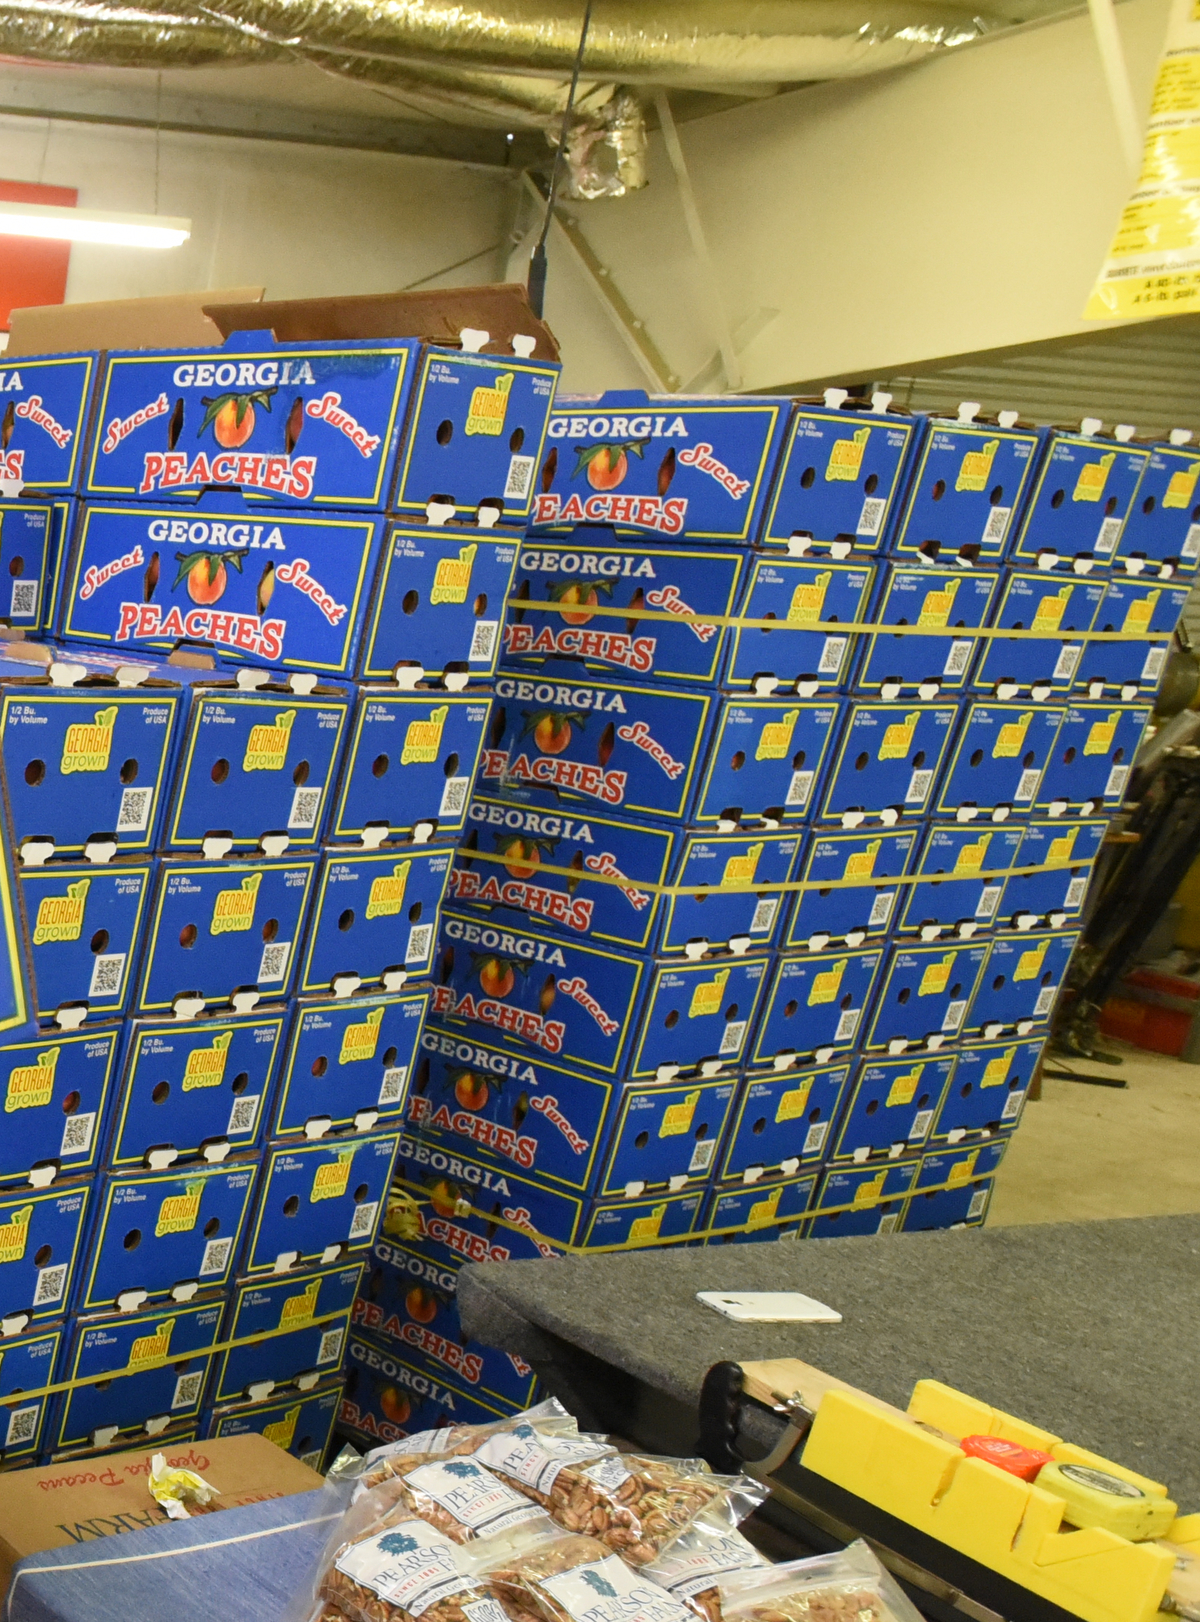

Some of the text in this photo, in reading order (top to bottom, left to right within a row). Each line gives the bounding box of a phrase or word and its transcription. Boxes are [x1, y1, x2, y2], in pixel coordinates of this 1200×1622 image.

[173, 361, 316, 387] GEORGIA
[16, 395, 73, 449] Sweet
[102, 392, 169, 454] Sweet
[305, 391, 381, 458] Sweet
[468, 417, 502, 431] grown
[547, 417, 688, 438] GEORGIA
[139, 452, 317, 499] PEACHES
[678, 442, 751, 500] Sweet
[531, 493, 688, 535] EACHES
[148, 520, 286, 550] GEORGIA
[80, 544, 144, 600] Sweet
[520, 552, 656, 578] GEORGIA
[275, 558, 348, 626] Sweet
[115, 602, 286, 660] PEACHES
[504, 623, 657, 672] EACHES
[495, 680, 627, 713] GEORGIA
[9, 716, 48, 725] by Volume
[143, 707, 169, 715] Produce
[145, 715, 167, 724] of USA
[67, 728, 109, 753] GEORGIA
[248, 728, 287, 753] GEORGIA
[406, 723, 441, 747] GEORGIA
[64, 754, 106, 769] grown
[247, 752, 285, 767] grown
[403, 747, 436, 762] grown
[617, 721, 685, 780] Sweet
[481, 749, 627, 805] EACHES
[469, 802, 594, 843] GEORGIA
[372, 878, 405, 902] GEORGIA
[40, 901, 82, 924] GEORGIA
[216, 894, 256, 916] GEORGIA
[368, 900, 400, 915] grown
[36, 924, 79, 940] grown
[212, 915, 250, 931] grown
[445, 920, 566, 968] GEORGIA
[431, 983, 566, 1053] EACHES
[557, 977, 620, 1036] Sweet
[345, 1024, 380, 1048] GEORGIA
[189, 1050, 226, 1073] GEORGIA
[340, 1045, 375, 1061] grown
[421, 1032, 538, 1084] GEORGIA
[10, 1068, 53, 1093] GEORGIA
[184, 1072, 221, 1089] grown
[7, 1090, 50, 1106] grown
[407, 1094, 538, 1168] EACHES
[529, 1095, 590, 1155] Sweet
[398, 1139, 511, 1197] GEORGIA
[56, 1197, 82, 1207] Produce
[67, 1204, 80, 1212] USA
[160, 1197, 198, 1220] GEORGIA
[157, 1217, 195, 1234] grown
[375, 1243, 457, 1292] GEORG
[350, 1342, 455, 1411] GEORGIA
[37, 1467, 124, 1492] Pecans
[394, 1579, 418, 1598] SINCE
[677, 1578, 713, 1597] Natural
